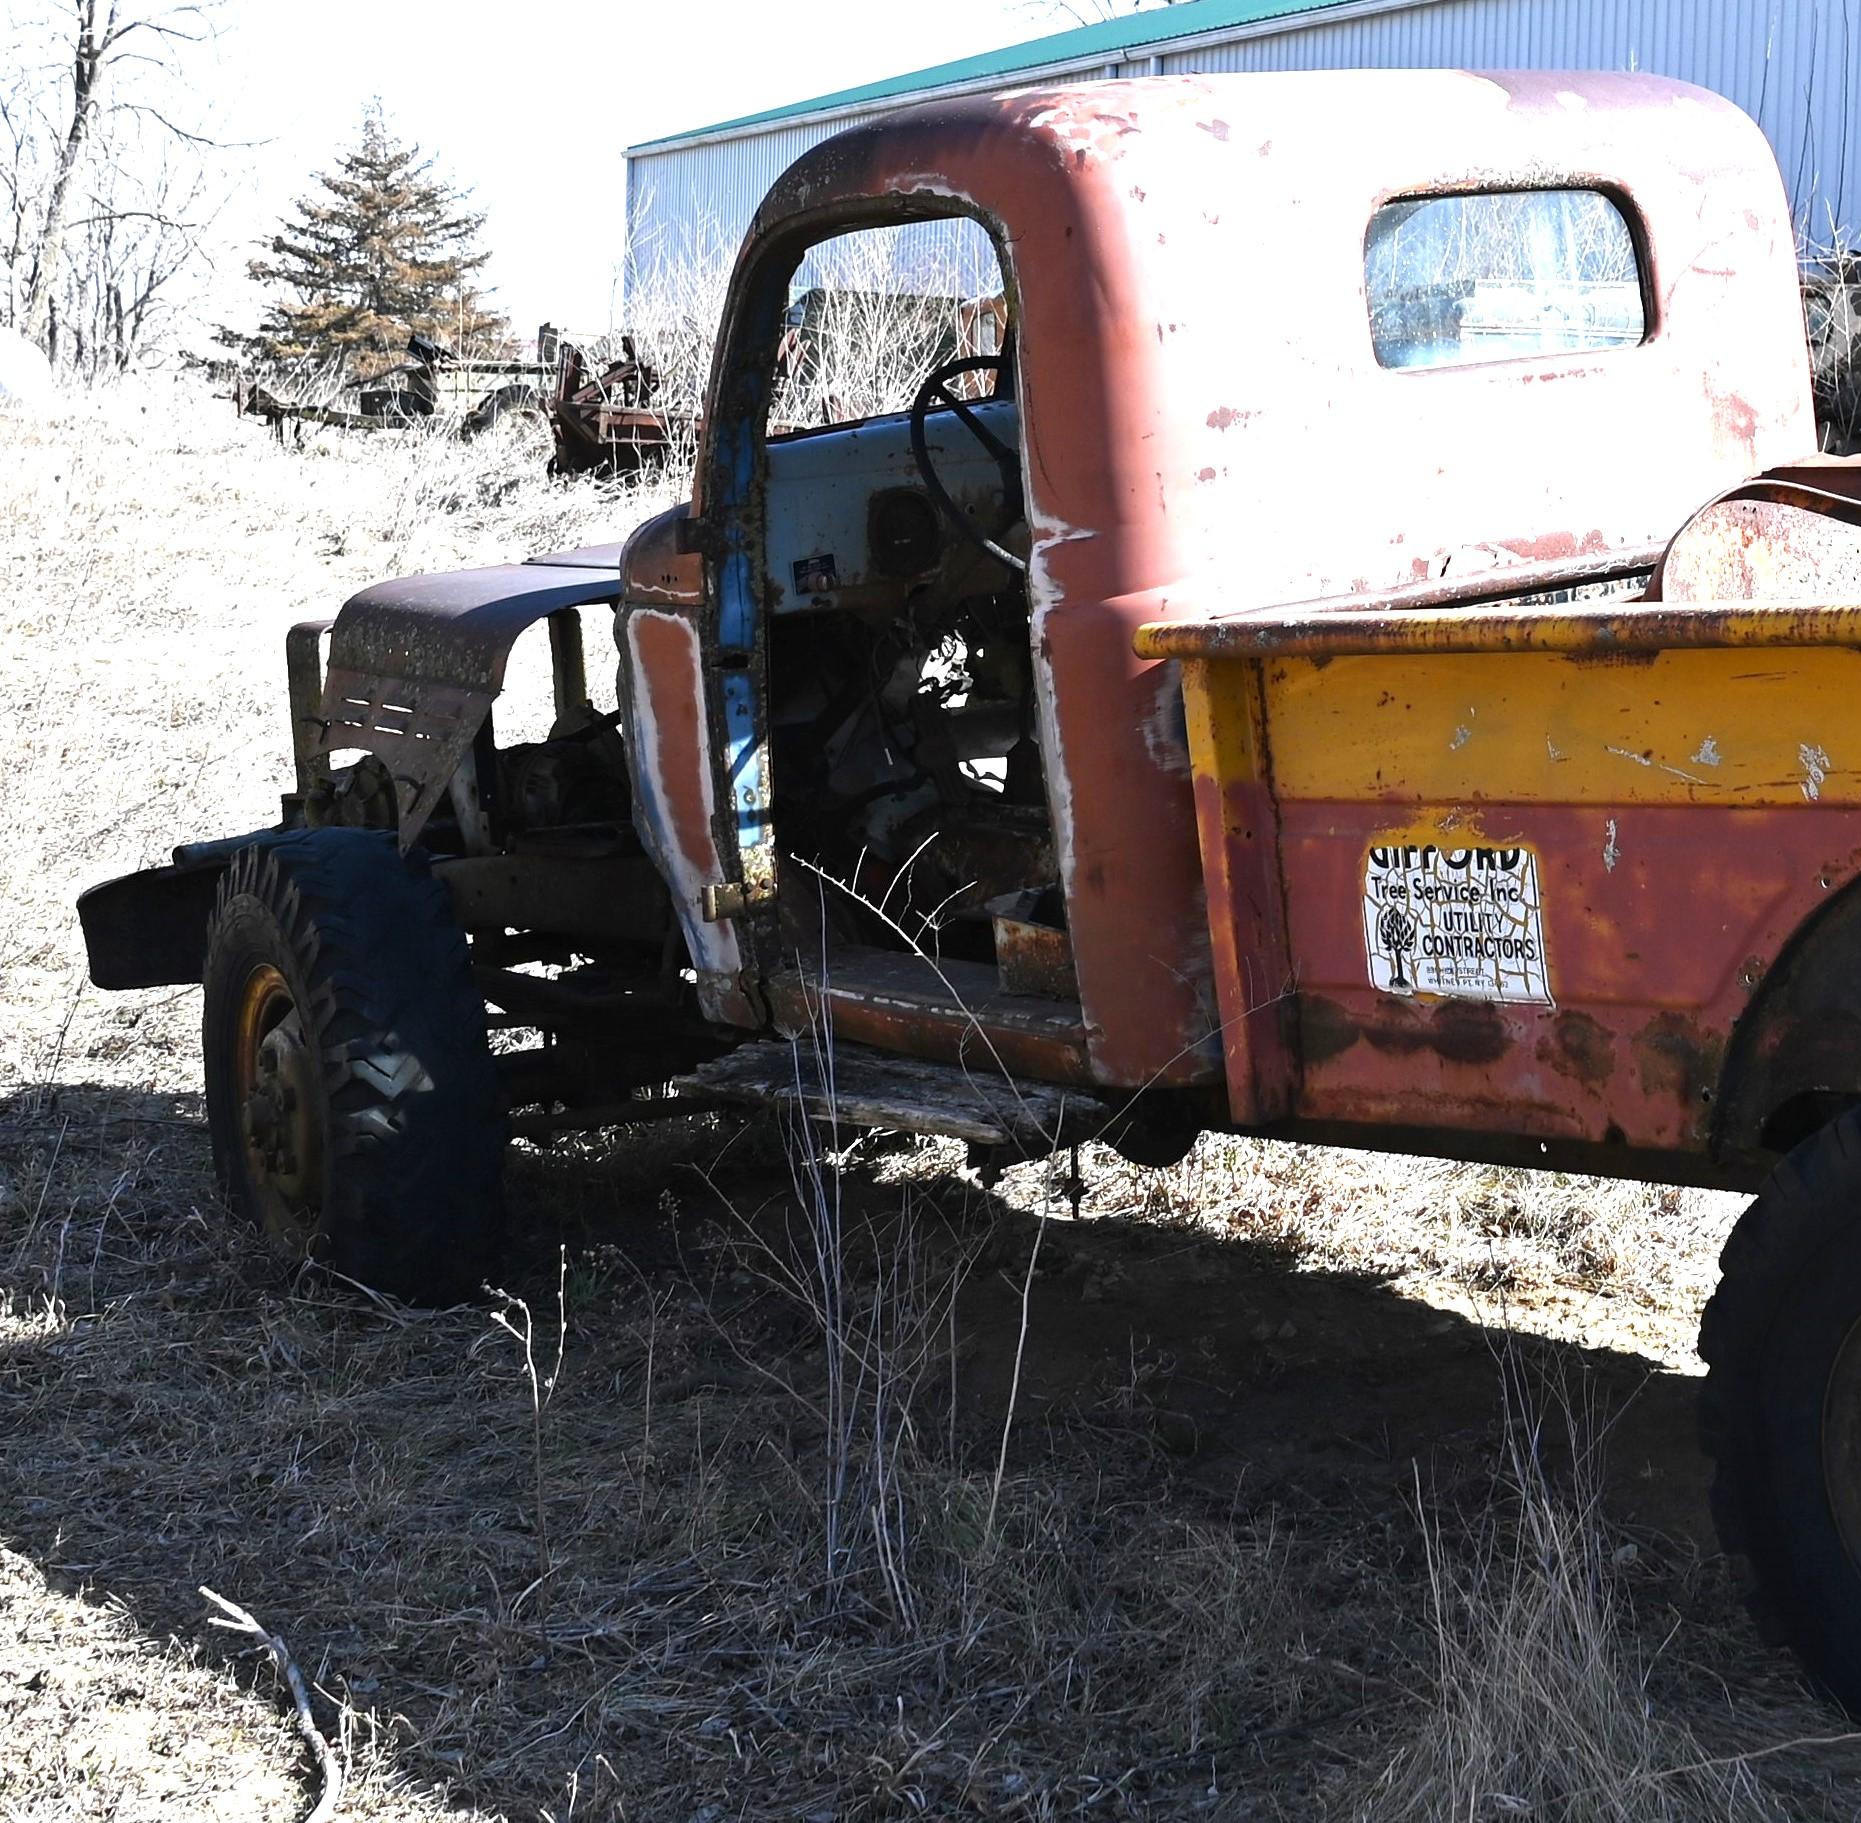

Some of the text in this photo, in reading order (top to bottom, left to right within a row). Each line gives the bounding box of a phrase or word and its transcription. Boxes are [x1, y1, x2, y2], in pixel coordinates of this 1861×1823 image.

[1371, 876, 1519, 902] Tree Service Inc
[1443, 911, 1503, 933] UTILITY
[1422, 934, 1535, 960] CONTRACTORS
